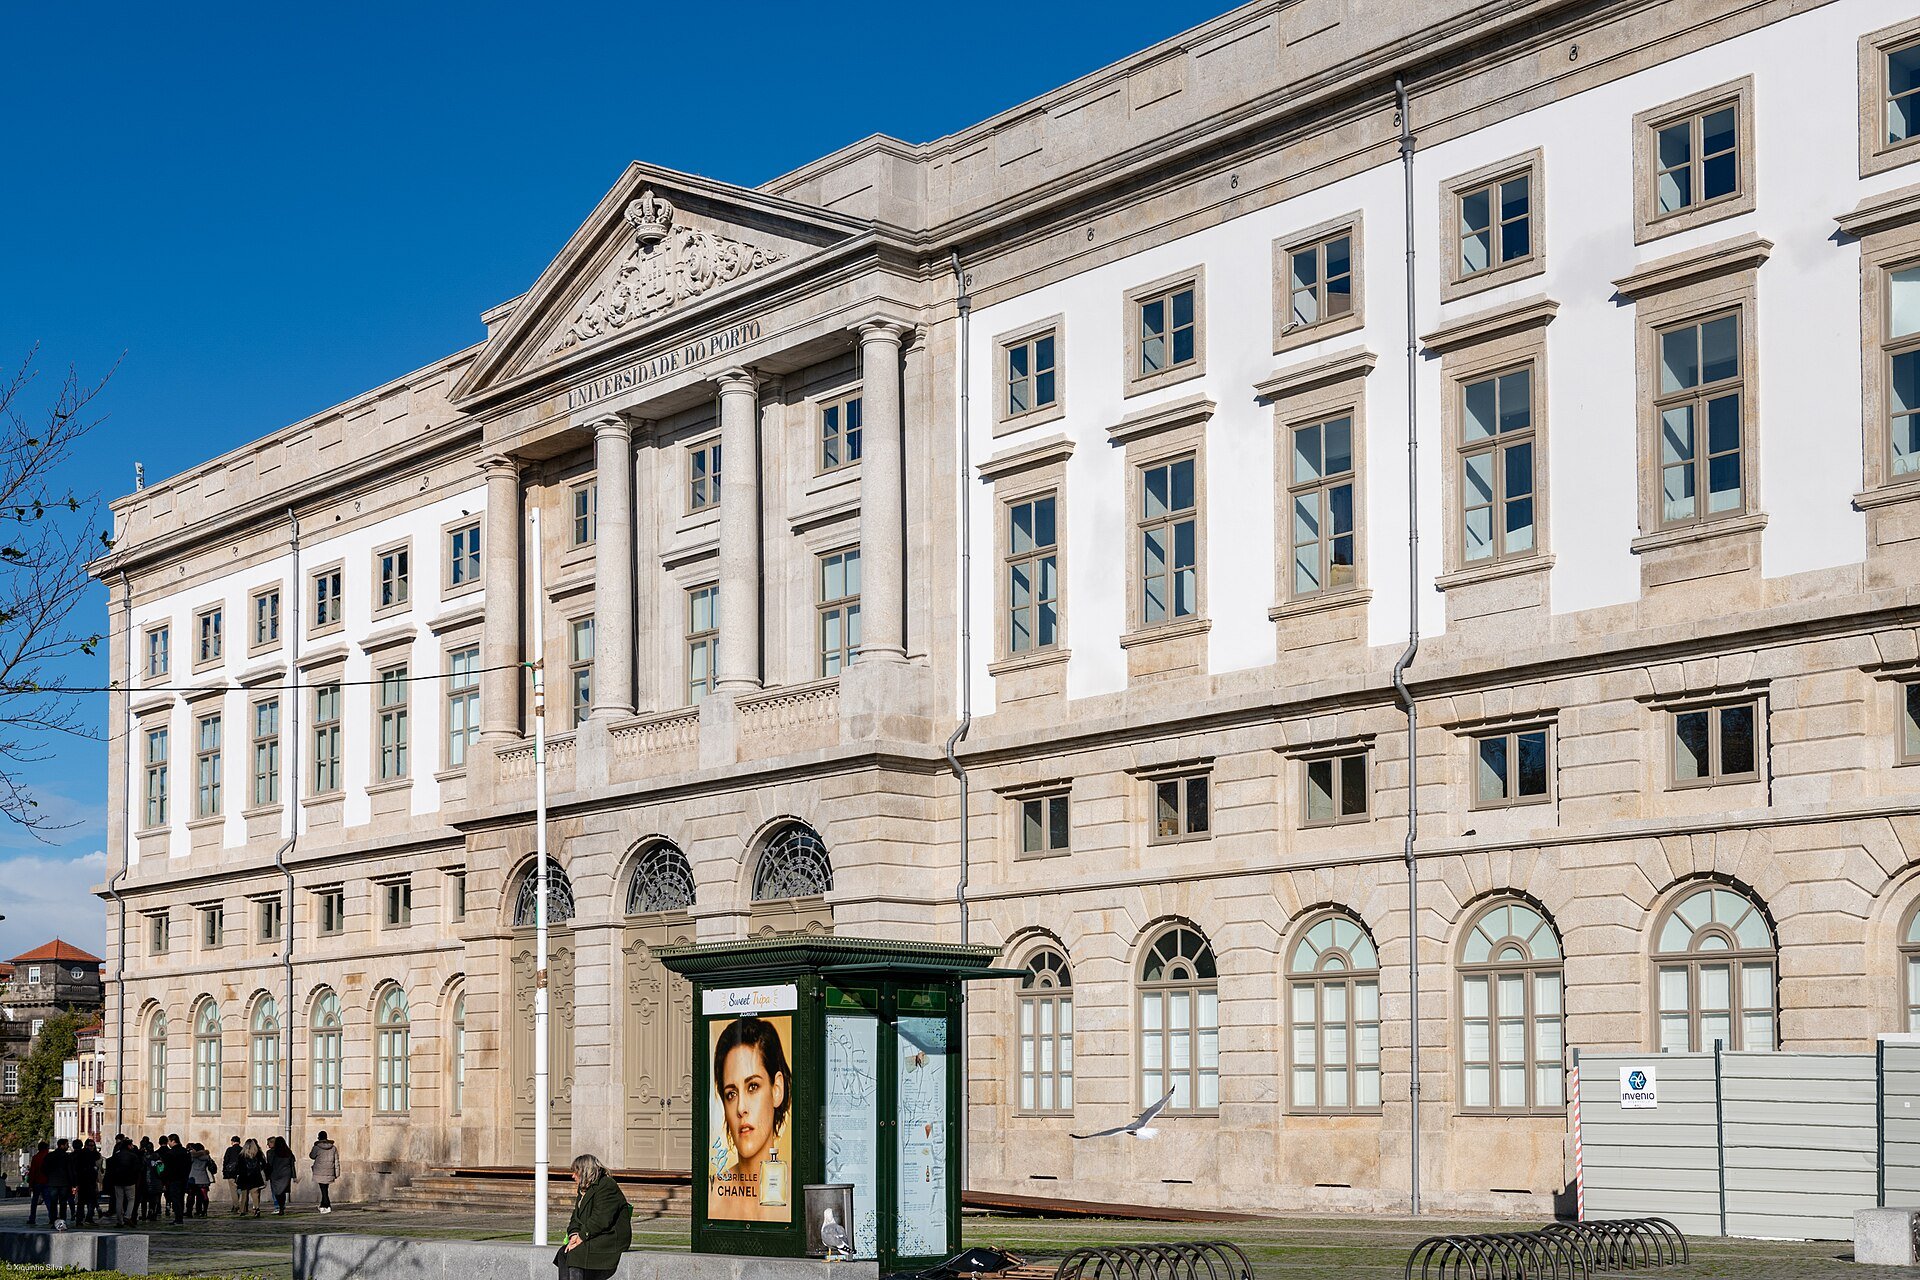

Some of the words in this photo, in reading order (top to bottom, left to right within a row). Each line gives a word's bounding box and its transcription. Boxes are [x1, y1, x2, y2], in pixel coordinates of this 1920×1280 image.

[568, 351, 680, 409] UNIVERSIDADE
[684, 341, 706, 366] DO
[710, 320, 761, 356] PORTO
[729, 993, 751, 1007] Sweet
[717, 1185, 757, 1197] CHANEL
